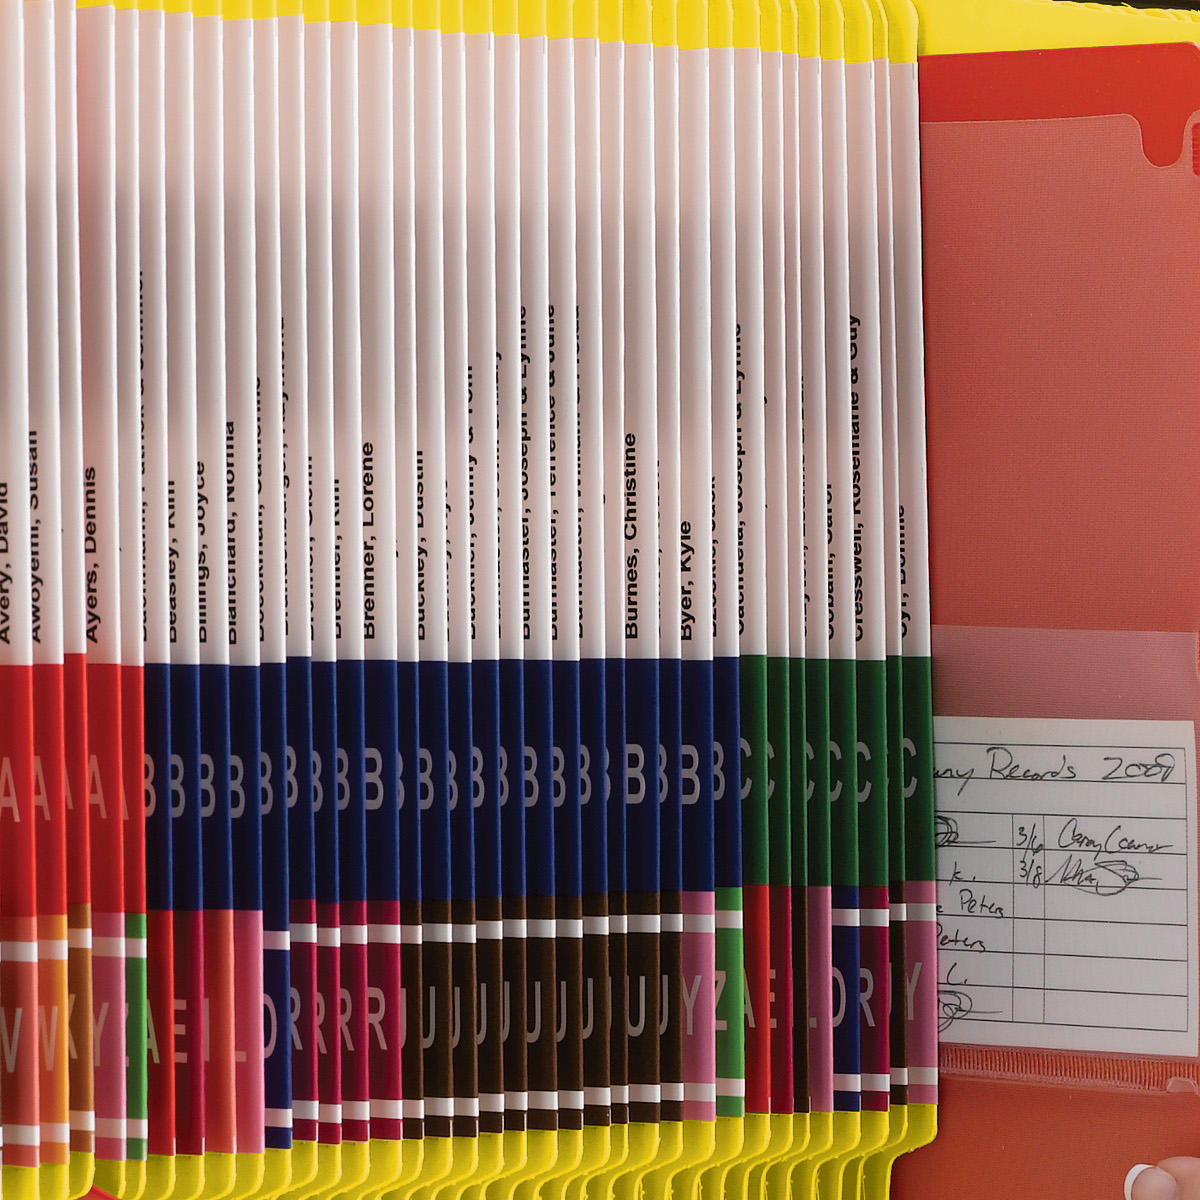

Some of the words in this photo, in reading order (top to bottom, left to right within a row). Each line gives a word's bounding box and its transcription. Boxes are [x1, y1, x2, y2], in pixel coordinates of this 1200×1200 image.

[29, 432, 38, 509] Susan
[363, 443, 373, 526] Lorene
[625, 434, 636, 540] Christine
[0, 483, 8, 553] David
[85, 468, 96, 553] Dennis
[681, 521, 694, 572] Kyle
[0, 564, 12, 644] Avery,
[87, 564, 100, 643] Ayers,
[364, 537, 376, 639] Brenner,
[626, 549, 639, 639] Burnes,
[681, 581, 695, 640] Byer,
[87, 755, 107, 819] A
[365, 748, 383, 810] B
[626, 744, 646, 804] B
[682, 744, 700, 805] B
[368, 987, 387, 1050] R
[627, 975, 646, 1037] U
[683, 975, 702, 1036] Y
